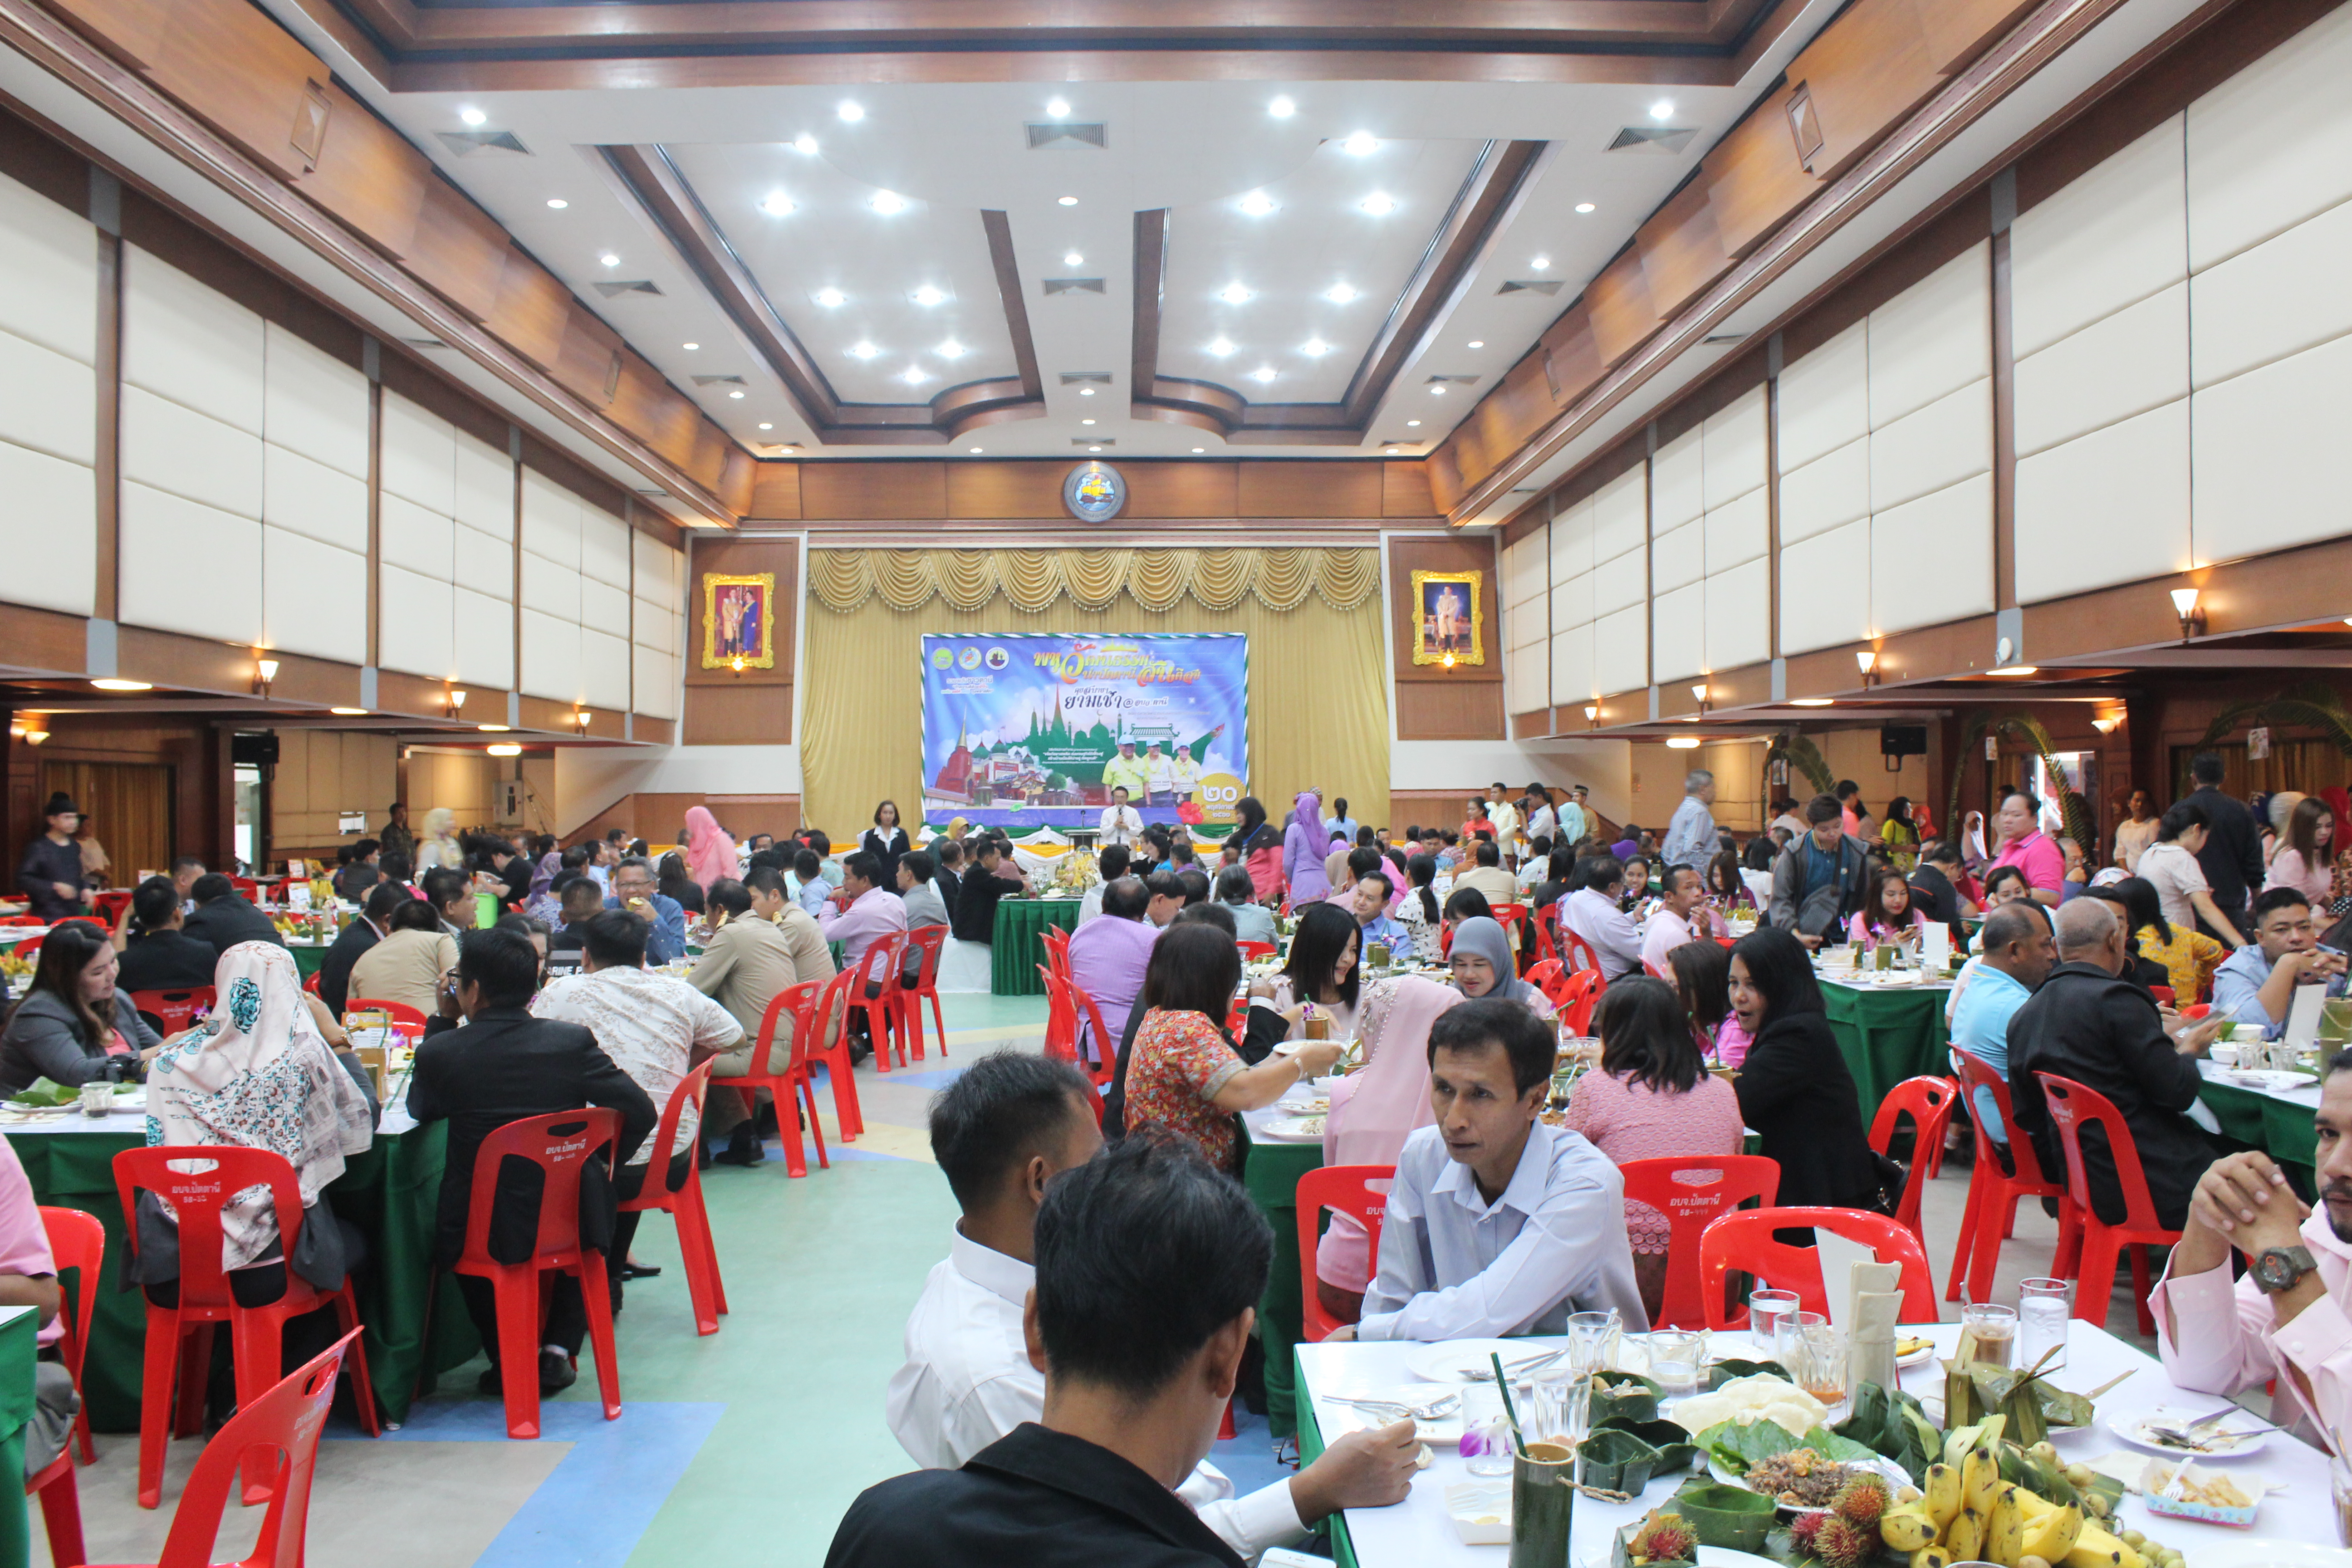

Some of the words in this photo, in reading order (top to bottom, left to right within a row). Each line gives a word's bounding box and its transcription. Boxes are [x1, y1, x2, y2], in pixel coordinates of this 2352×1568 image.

[1064, 690, 1122, 709] ยามเช้า
[1202, 785, 1237, 802] ๒๐
[546, 1138, 586, 1154] อบจ.ปัตตานี
[172, 1181, 220, 1193] อบจ.ปัตตานี
[1670, 1193, 1721, 1206] อบจ.ปัตตานี
